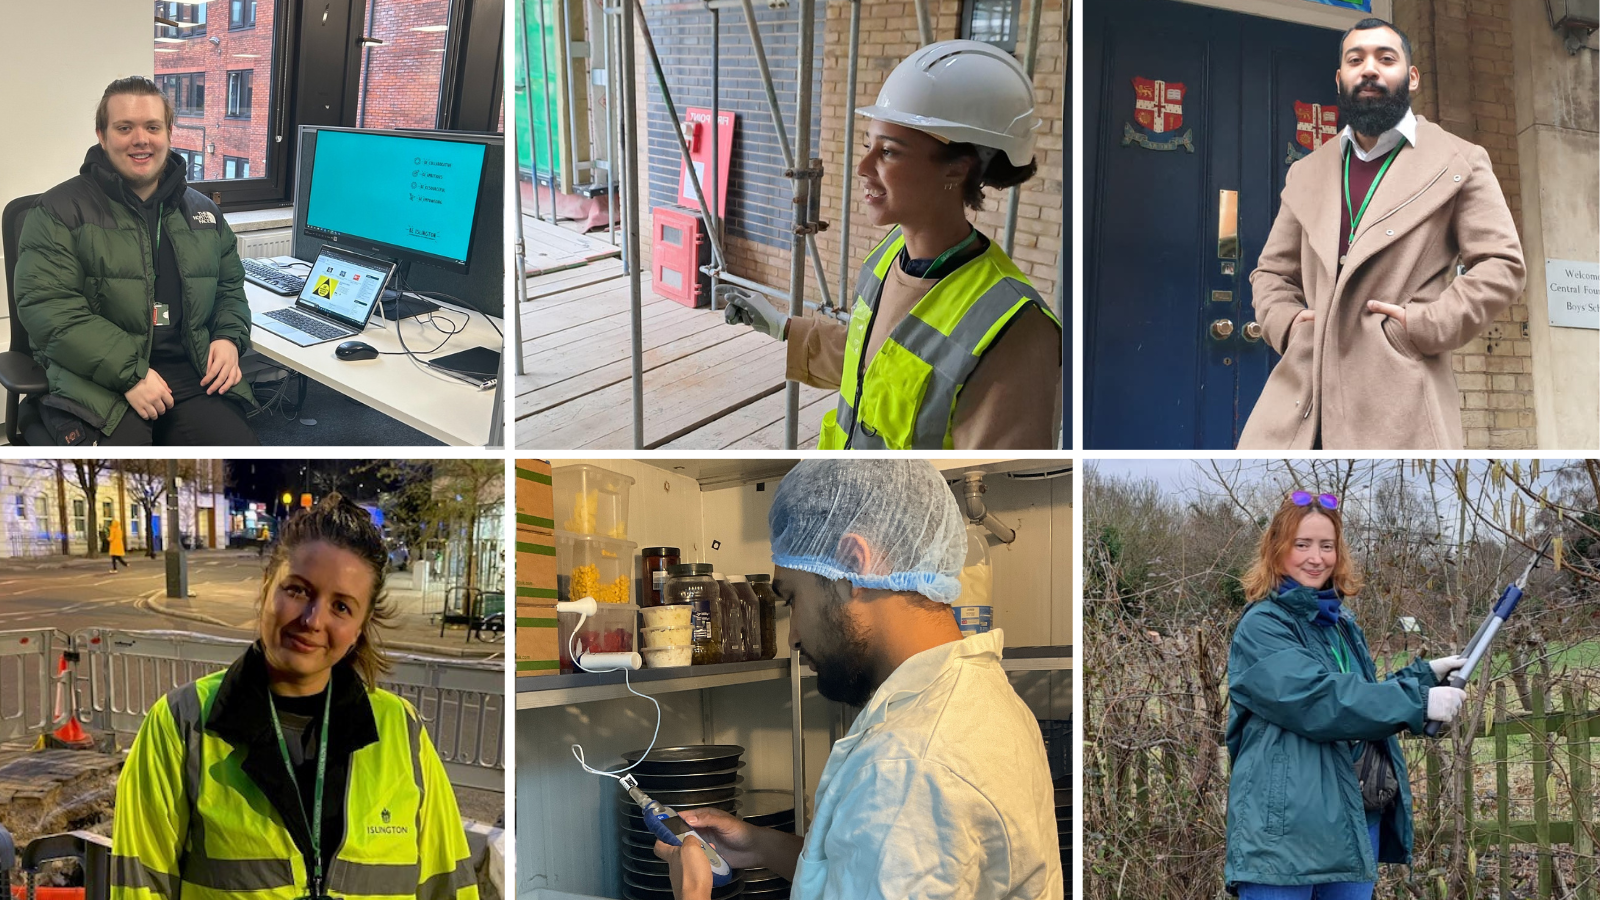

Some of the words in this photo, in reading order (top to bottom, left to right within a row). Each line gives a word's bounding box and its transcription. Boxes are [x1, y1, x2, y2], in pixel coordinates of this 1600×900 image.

[1550, 283, 1580, 293] Central
[1584, 285, 1600, 295] Fou
[367, 826, 408, 834] ISLINGTON
